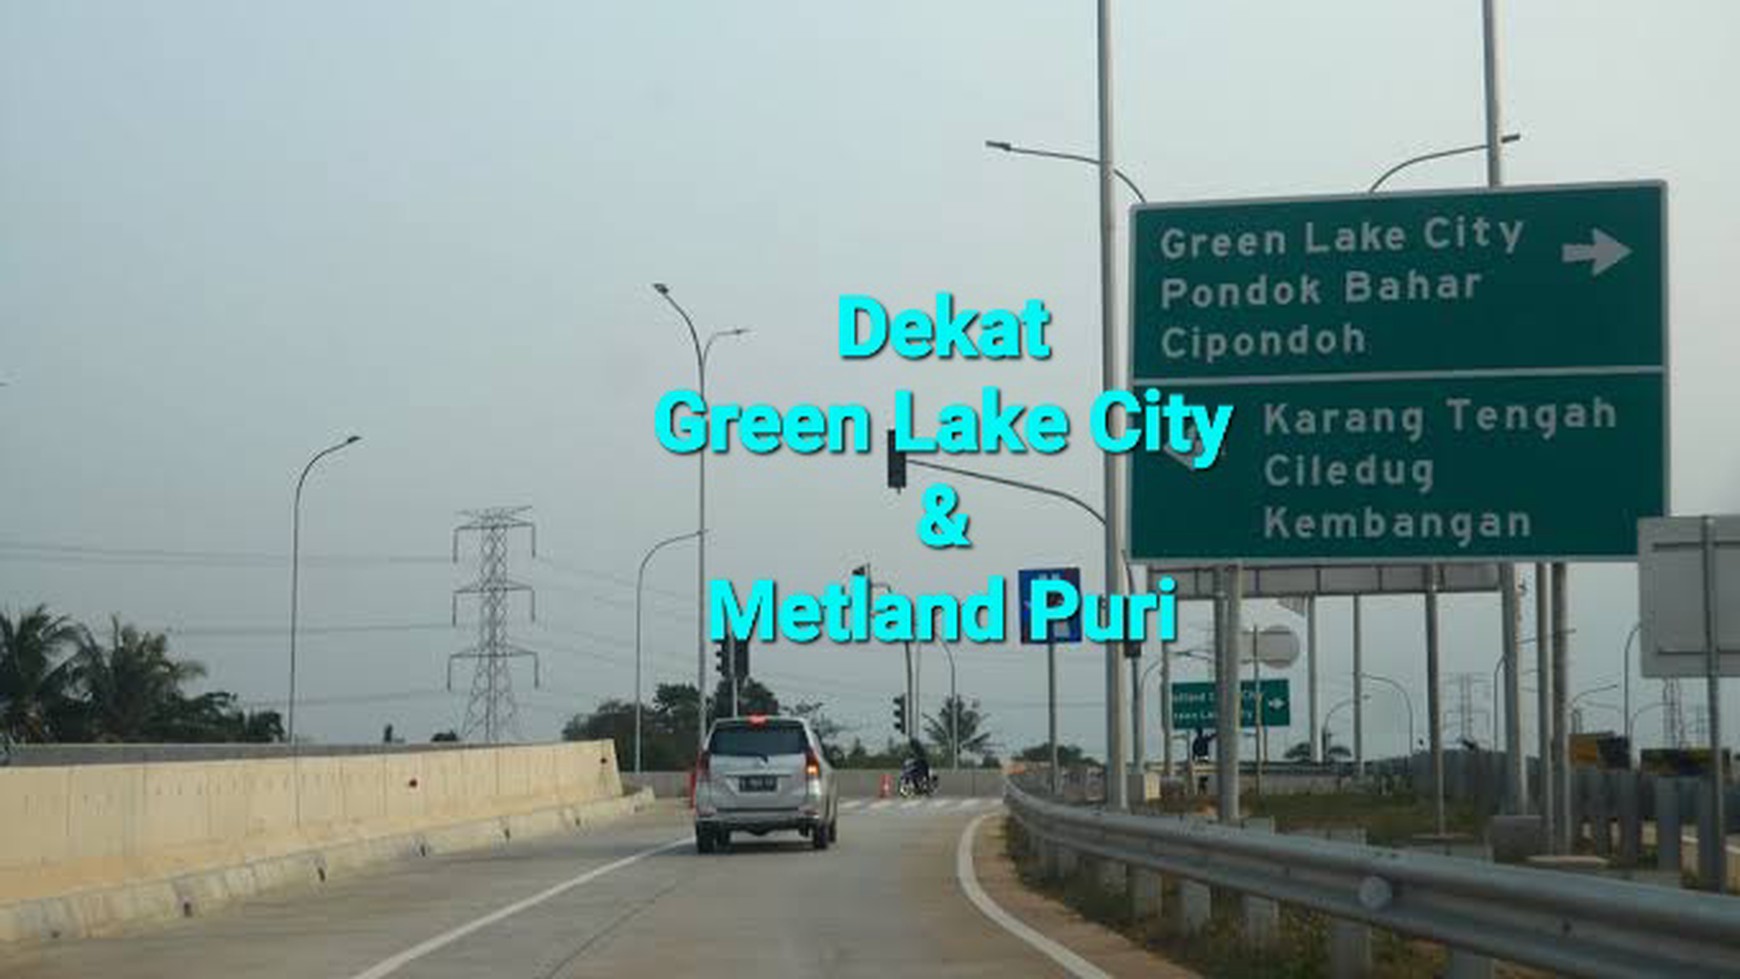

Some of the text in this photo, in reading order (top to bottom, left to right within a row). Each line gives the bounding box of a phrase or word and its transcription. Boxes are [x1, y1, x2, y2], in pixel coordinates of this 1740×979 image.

[1160, 215, 1524, 260] Green Lake City
[1161, 269, 1481, 309] Pondok Bahar
[1161, 323, 1366, 363] Cipondoh
[1264, 397, 1617, 442] Karang Tengah
[1265, 453, 1435, 493] Ciledug
[1264, 506, 1531, 547] Kembangan
